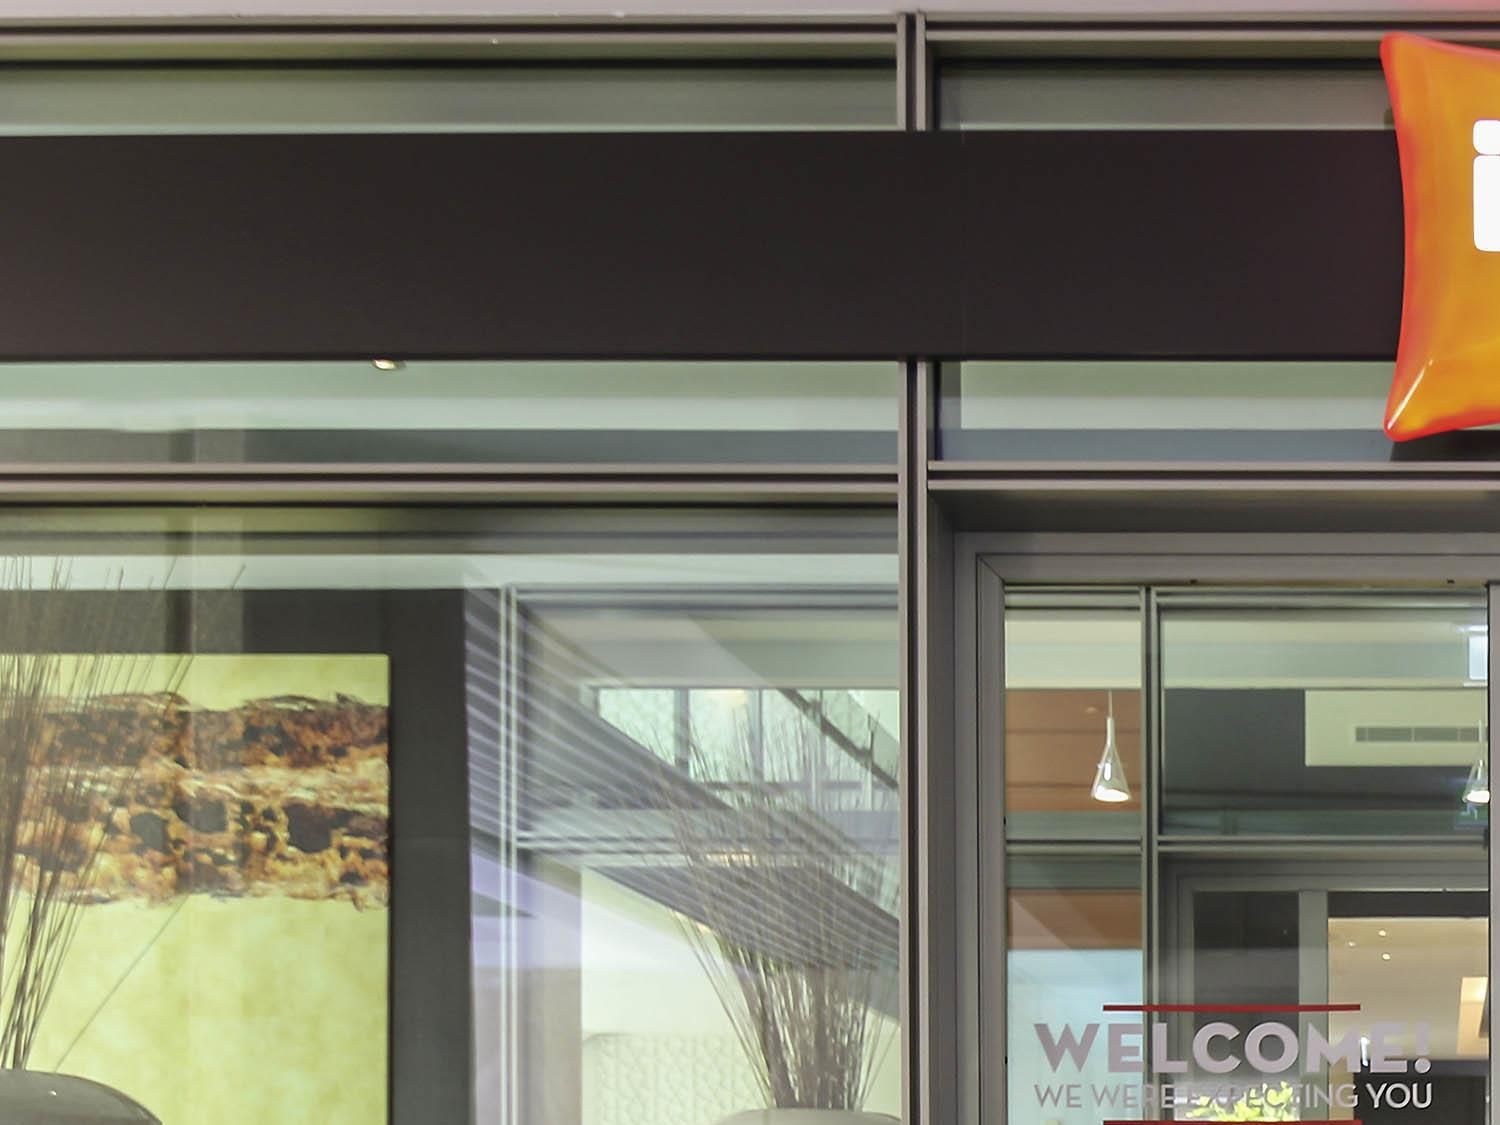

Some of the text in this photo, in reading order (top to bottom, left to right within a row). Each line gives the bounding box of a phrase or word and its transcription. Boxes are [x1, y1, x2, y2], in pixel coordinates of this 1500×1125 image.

[1033, 1022, 1433, 1074] WELCOME!
[1034, 1083, 1083, 1109] WE
[1092, 1083, 1175, 1109] WERE
[1365, 1082, 1434, 1110] YOU
